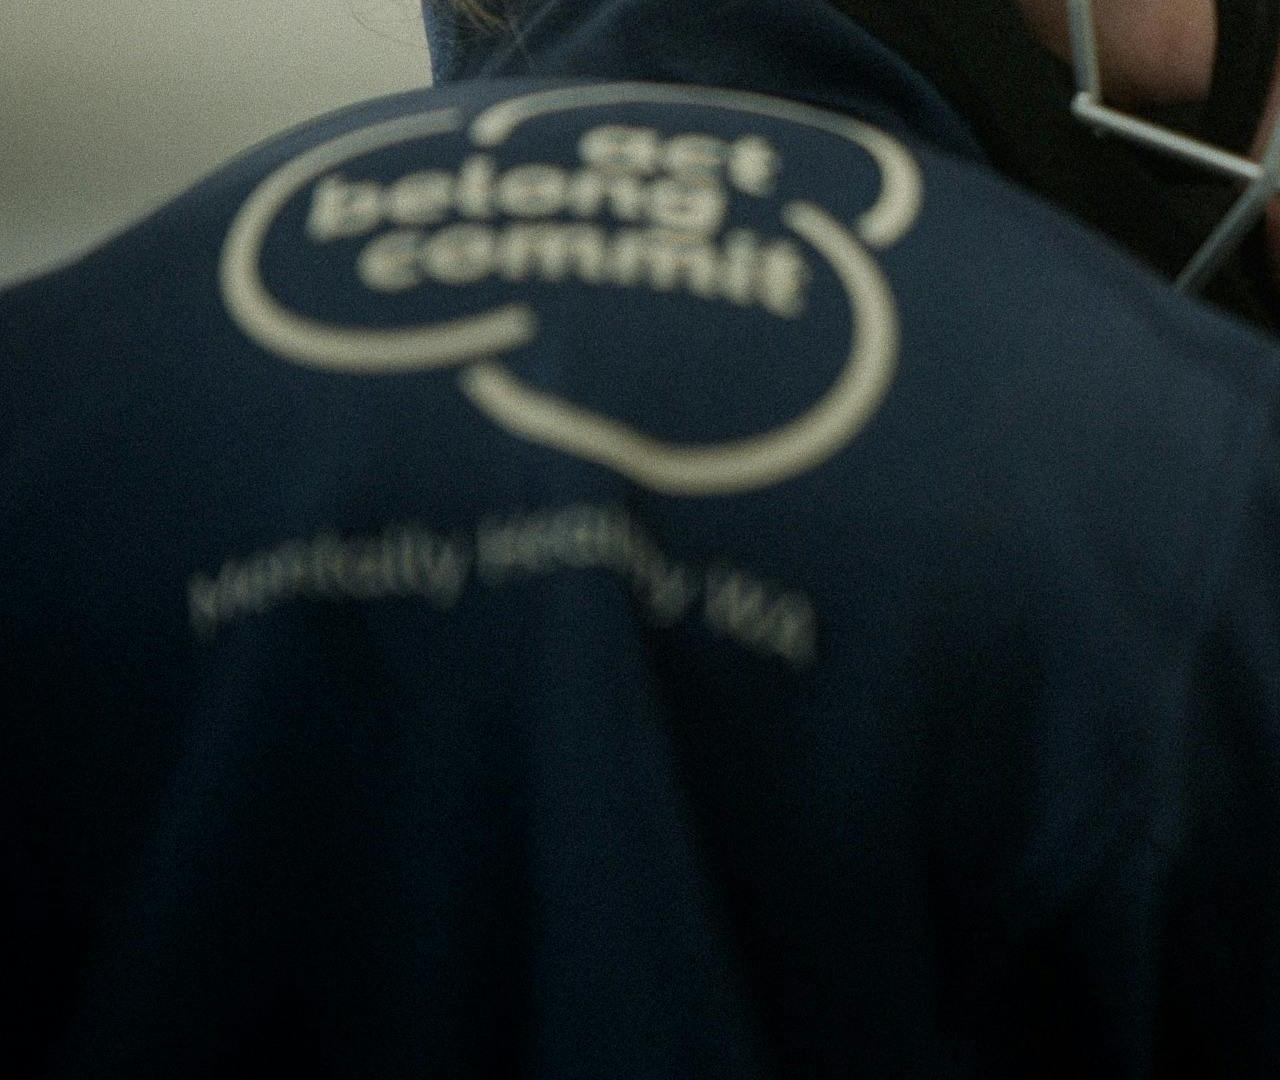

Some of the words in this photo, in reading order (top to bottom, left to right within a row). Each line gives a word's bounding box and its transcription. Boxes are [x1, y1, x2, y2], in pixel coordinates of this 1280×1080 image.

[309, 153, 726, 240] belong
[580, 125, 778, 194] act
[356, 222, 808, 317] commit
